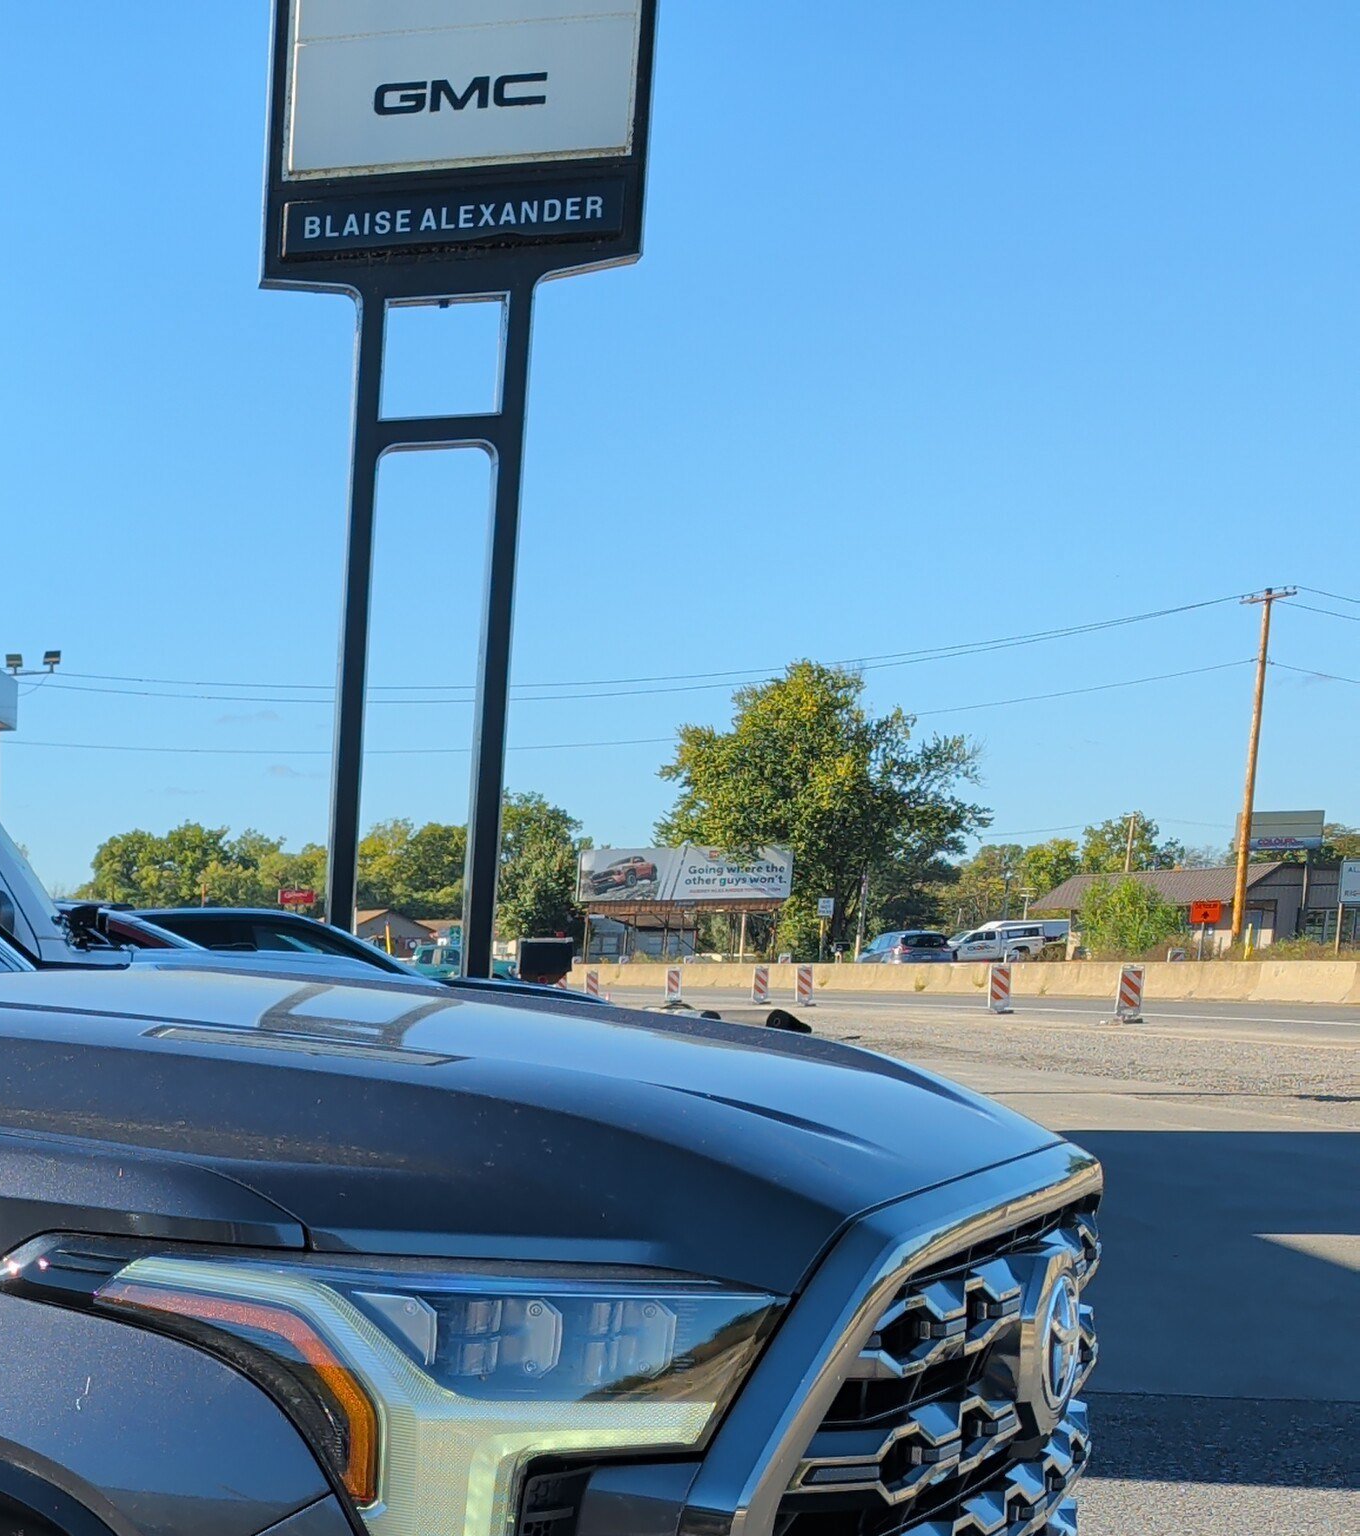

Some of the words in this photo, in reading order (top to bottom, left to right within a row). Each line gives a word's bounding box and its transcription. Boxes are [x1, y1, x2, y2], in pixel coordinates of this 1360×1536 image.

[374, 72, 548, 115] GMC
[304, 209, 411, 239] BLAISE
[420, 196, 603, 231] ALEXANDER
[684, 876, 717, 885] other
[719, 877, 747, 886] guys
[749, 874, 787, 884] won't.
[688, 865, 724, 876] Going
[765, 863, 786, 873] the
